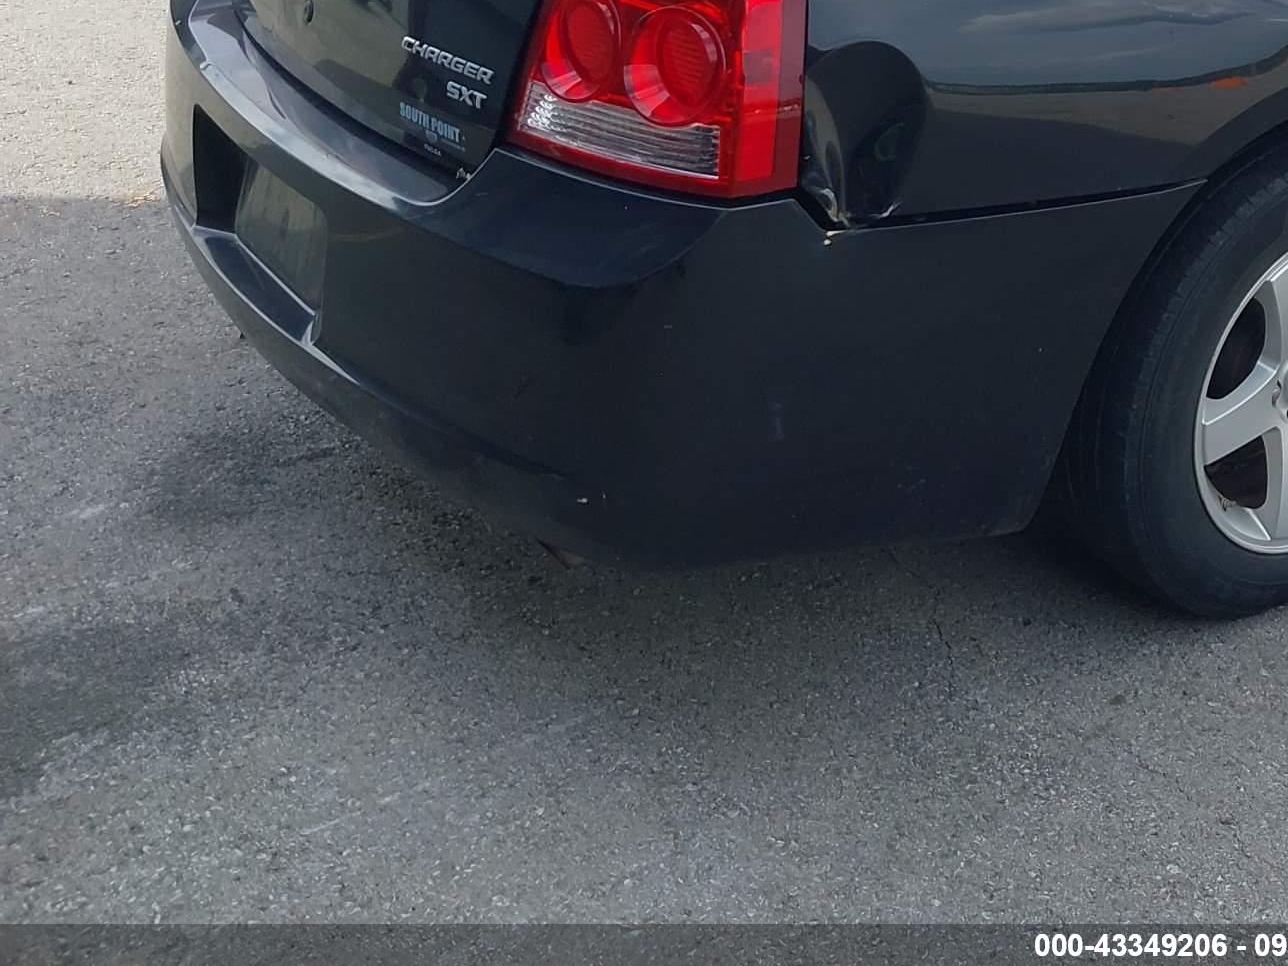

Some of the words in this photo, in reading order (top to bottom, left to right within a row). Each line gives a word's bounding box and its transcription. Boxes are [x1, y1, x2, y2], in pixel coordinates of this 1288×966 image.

[401, 35, 495, 85] CHARGER
[446, 81, 488, 109] SXT
[399, 101, 430, 129] SOUTH
[430, 116, 461, 143] POINT
